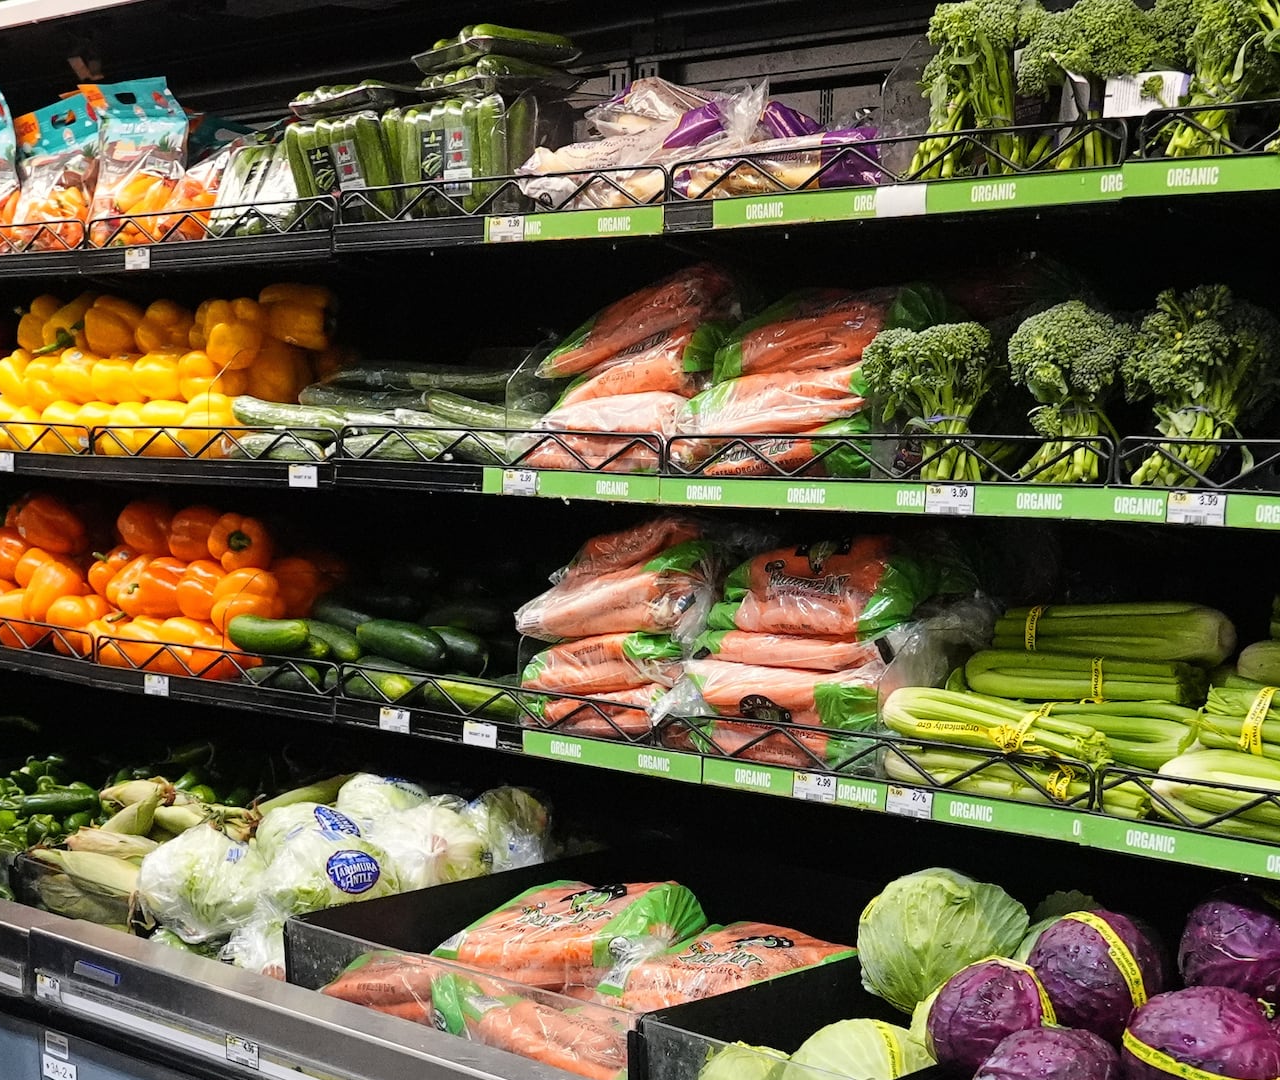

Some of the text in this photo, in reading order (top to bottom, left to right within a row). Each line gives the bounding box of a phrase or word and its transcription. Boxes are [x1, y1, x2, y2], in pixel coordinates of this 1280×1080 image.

[1167, 166, 1220, 186] ORGANIC
[971, 183, 1016, 202] ORGANIC
[746, 202, 783, 220] ORGANIC
[524, 220, 542, 236] ANIC
[598, 216, 630, 232] ORGANIC
[595, 479, 629, 497] ORGANIC
[686, 485, 723, 501] ORGANIC
[786, 487, 826, 504] ORGANIC
[896, 489, 925, 507] ORGA
[1016, 492, 1063, 511] ORGANIC
[1113, 496, 1163, 516] ORGANIC
[936, 722, 980, 733] Organically
[550, 740, 582, 759] ORGANIC
[637, 753, 671, 772] ORGANIC
[734, 768, 771, 789] ORGANIC
[837, 783, 878, 806] ORGANIC
[948, 801, 993, 823] ORGANIC
[1124, 829, 1175, 855] ORGANIC
[329, 861, 378, 880] TANIMURA
